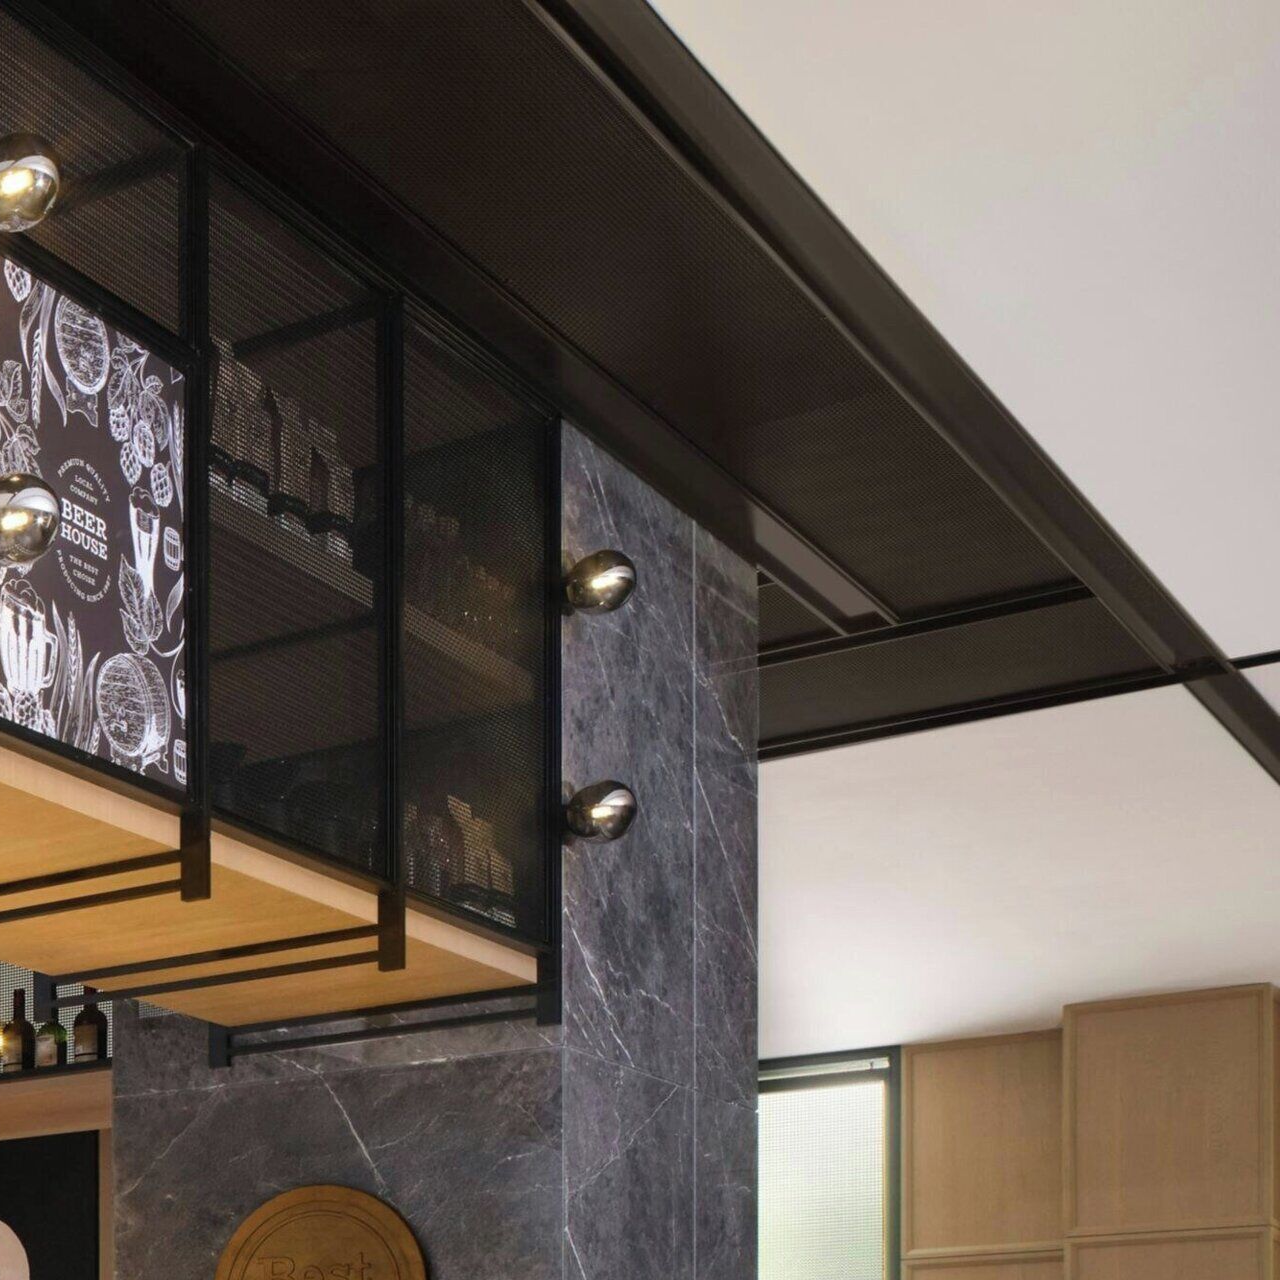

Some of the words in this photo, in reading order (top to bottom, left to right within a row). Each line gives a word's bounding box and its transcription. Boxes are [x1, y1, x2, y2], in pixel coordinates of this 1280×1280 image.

[57, 458, 85, 479] PREMIUM
[85, 463, 111, 502] QUALITY
[69, 484, 98, 506] COMPANY
[74, 475, 94, 491] LOCAL
[61, 498, 107, 541] BEER
[60, 521, 107, 561] HOUSE
[69, 554, 83, 568] THE
[83, 561, 99, 576] BEST
